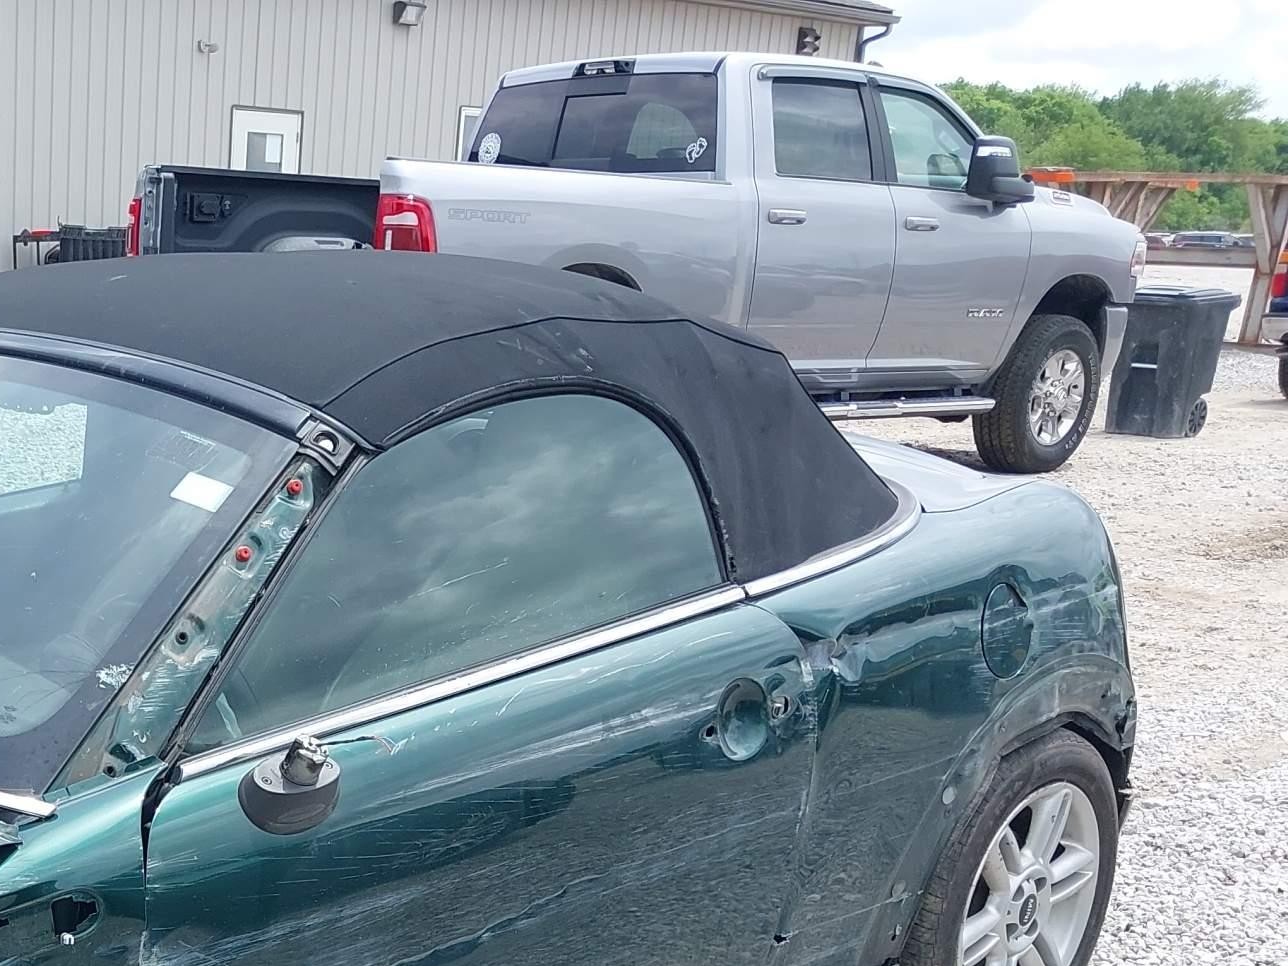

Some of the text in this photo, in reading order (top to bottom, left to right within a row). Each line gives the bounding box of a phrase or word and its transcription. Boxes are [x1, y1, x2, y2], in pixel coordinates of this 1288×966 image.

[447, 207, 531, 225] SPORT
[967, 308, 1004, 318] RAM
[1023, 898, 1034, 923] MINI
